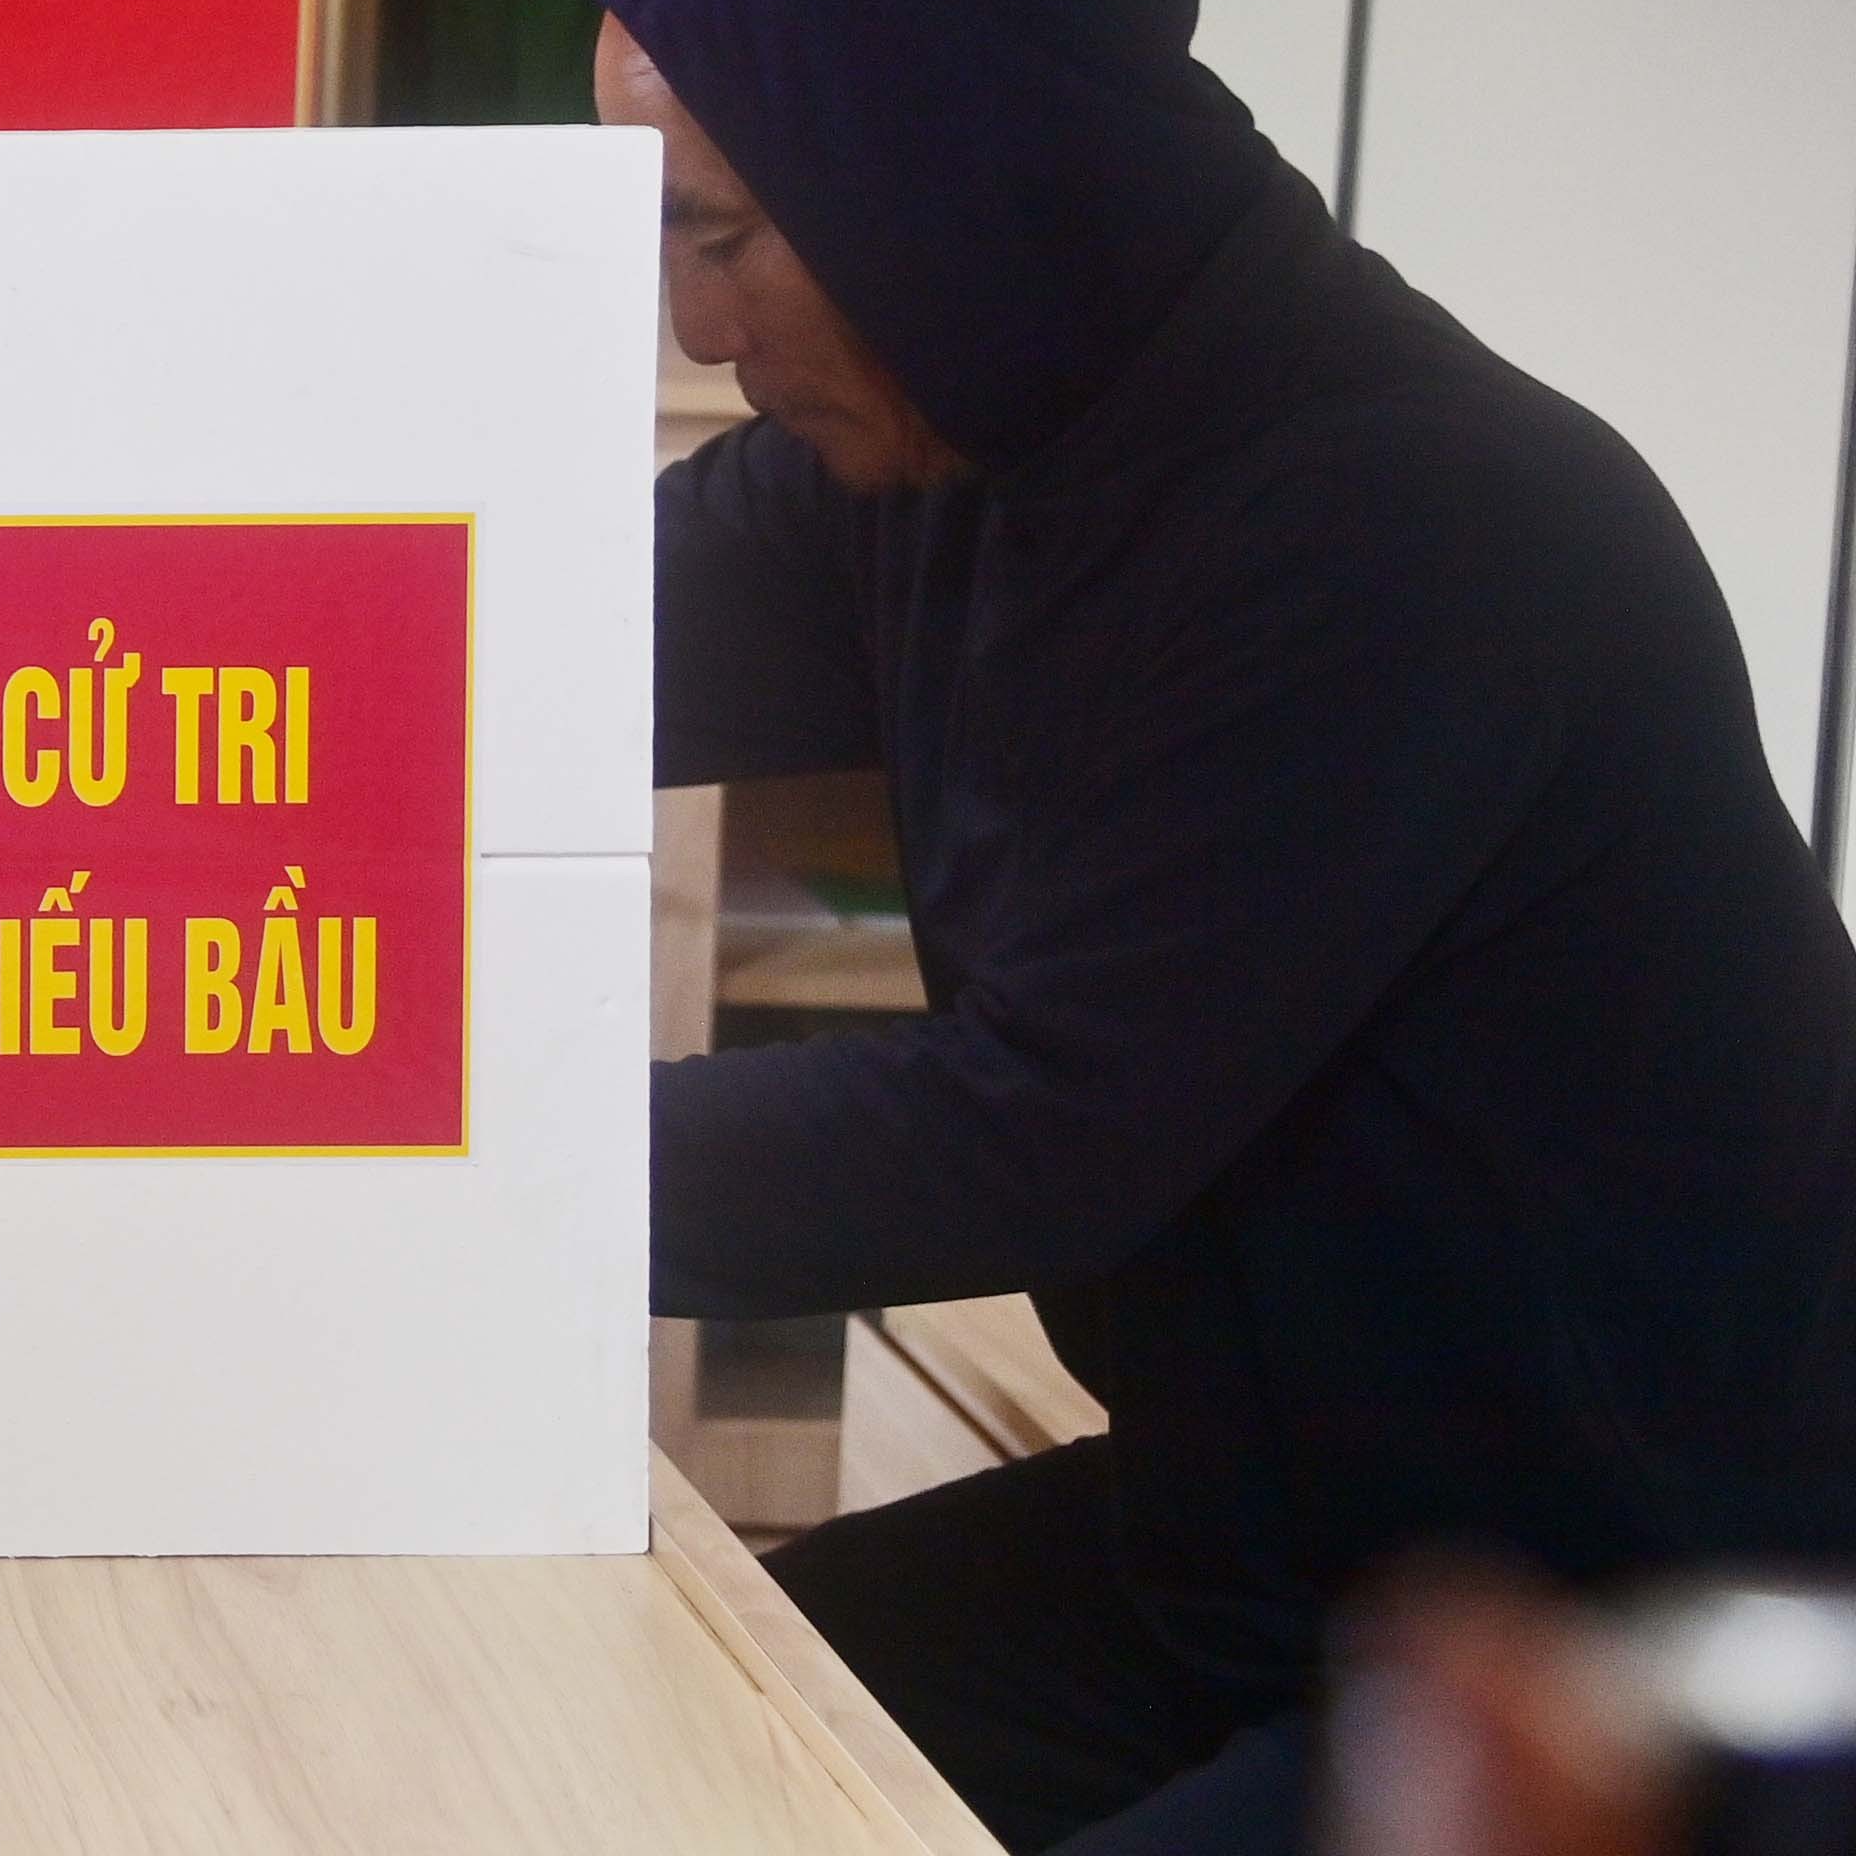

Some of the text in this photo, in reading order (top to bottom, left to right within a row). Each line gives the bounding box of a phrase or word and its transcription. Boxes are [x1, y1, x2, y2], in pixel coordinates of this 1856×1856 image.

[1, 617, 142, 808] CỬ
[161, 666, 311, 805] TRI
[185, 865, 378, 1056] BẦU
